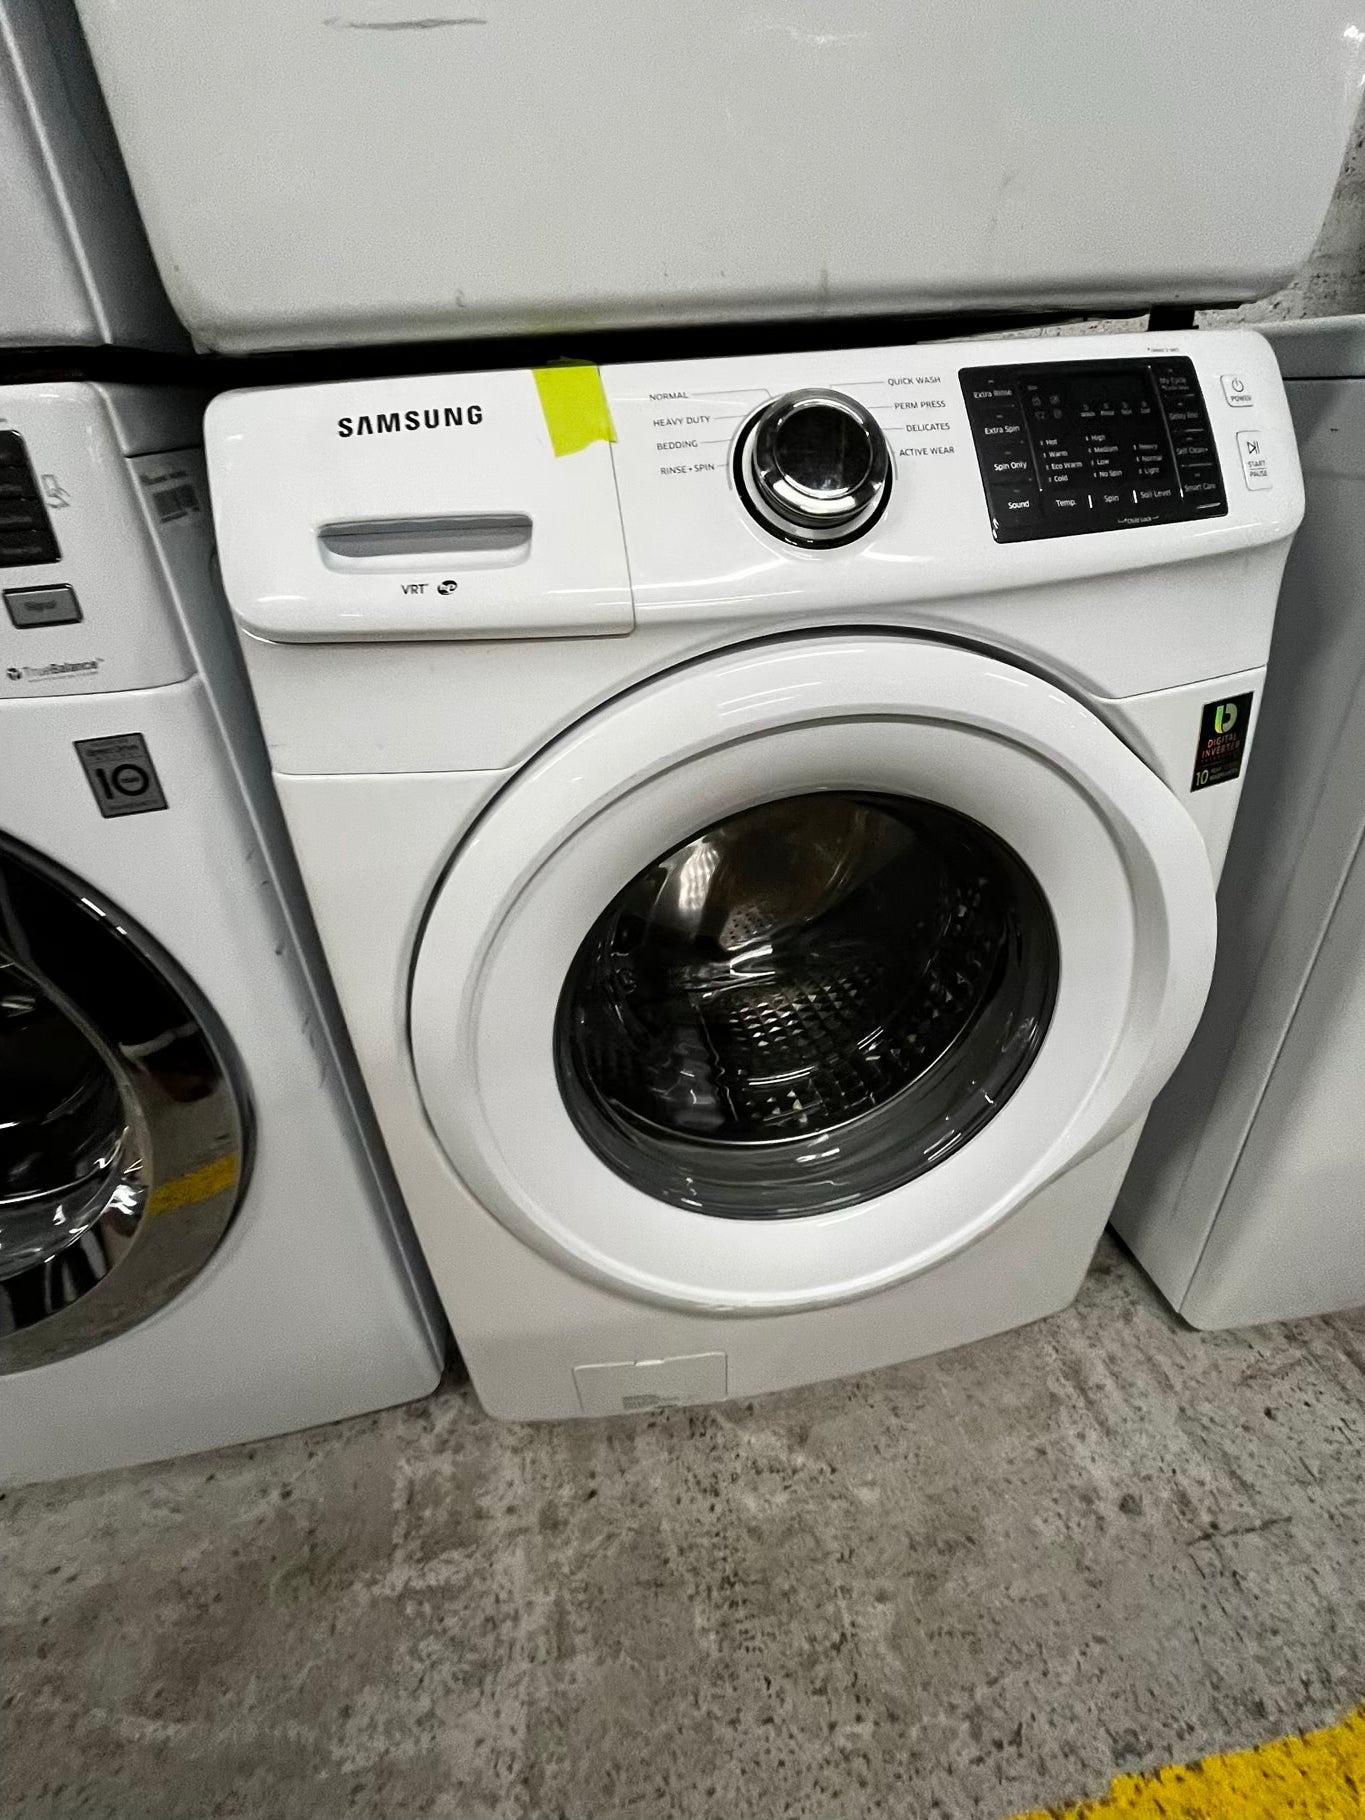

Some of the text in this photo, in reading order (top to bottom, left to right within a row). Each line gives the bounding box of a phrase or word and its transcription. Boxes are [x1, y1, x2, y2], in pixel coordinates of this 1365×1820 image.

[888, 376, 941, 386] QUICK WASH
[649, 392, 689, 400] NORMAL
[894, 400, 946, 410] PERM PRESS
[338, 405, 483, 438] SAMSUNG
[653, 415, 710, 427] HEAVY DUTY
[906, 423, 950, 432] DELICATES
[984, 425, 1020, 435] Extra Spin
[657, 440, 698, 451] BEDDING
[900, 446, 955, 457] ACTIVE WEAR
[660, 463, 715, 475] RINSE SPIN
[993, 461, 1027, 471] Spin Only
[1063, 461, 1083, 469] Warm
[1109, 469, 1123, 477] Spin
[1250, 469, 1268, 477] PAUSE
[1054, 475, 1068, 483] Cold
[1103, 495, 1120, 503] Spin
[1140, 489, 1172, 499] Soil Level
[1007, 500, 1030, 509] Sound
[1055, 499, 1077, 507] Temp.
[1195, 770, 1209, 786] 10
